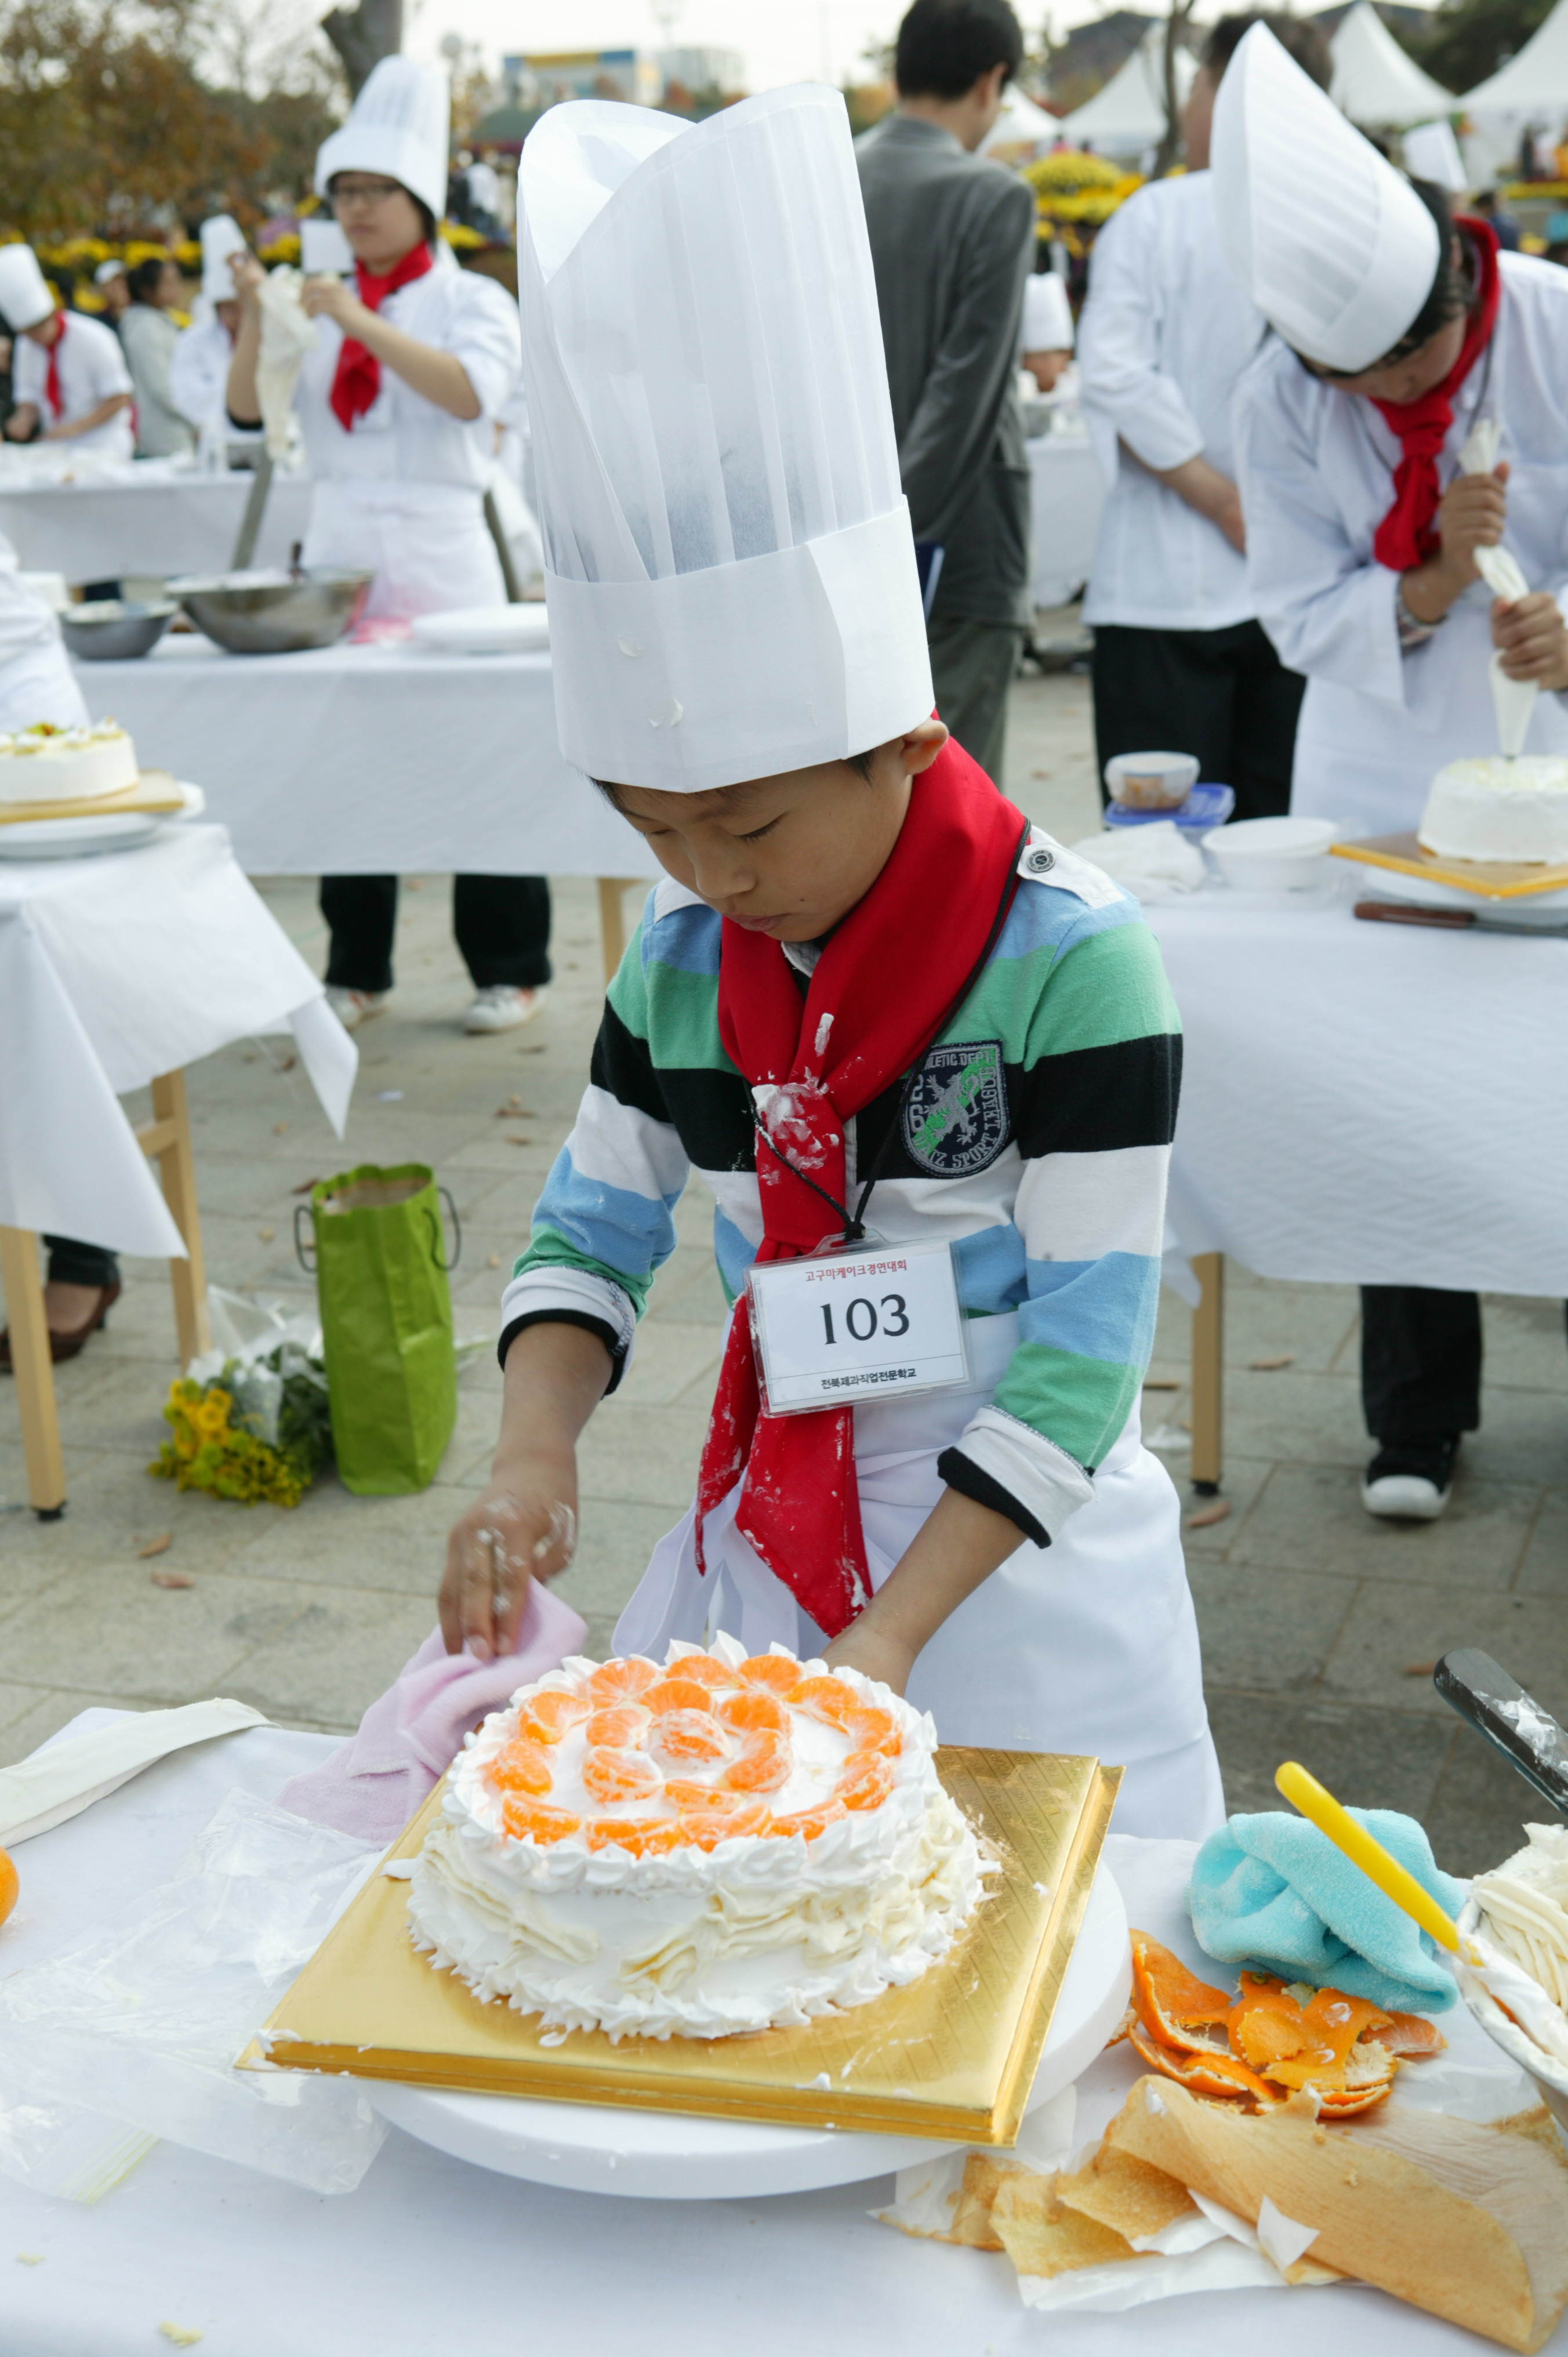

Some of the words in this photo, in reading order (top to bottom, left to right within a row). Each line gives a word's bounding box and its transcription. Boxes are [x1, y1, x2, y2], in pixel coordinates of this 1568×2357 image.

[925, 1053, 958, 1069] HLETIC
[952, 1132, 998, 1169] SPORT
[981, 1066, 1001, 1131] LEAGUE
[805, 1259, 907, 1282] 고구마케이크경연대회
[819, 1293, 910, 1345] 103
[821, 1368, 916, 1390] 전북제과직업전문학교
